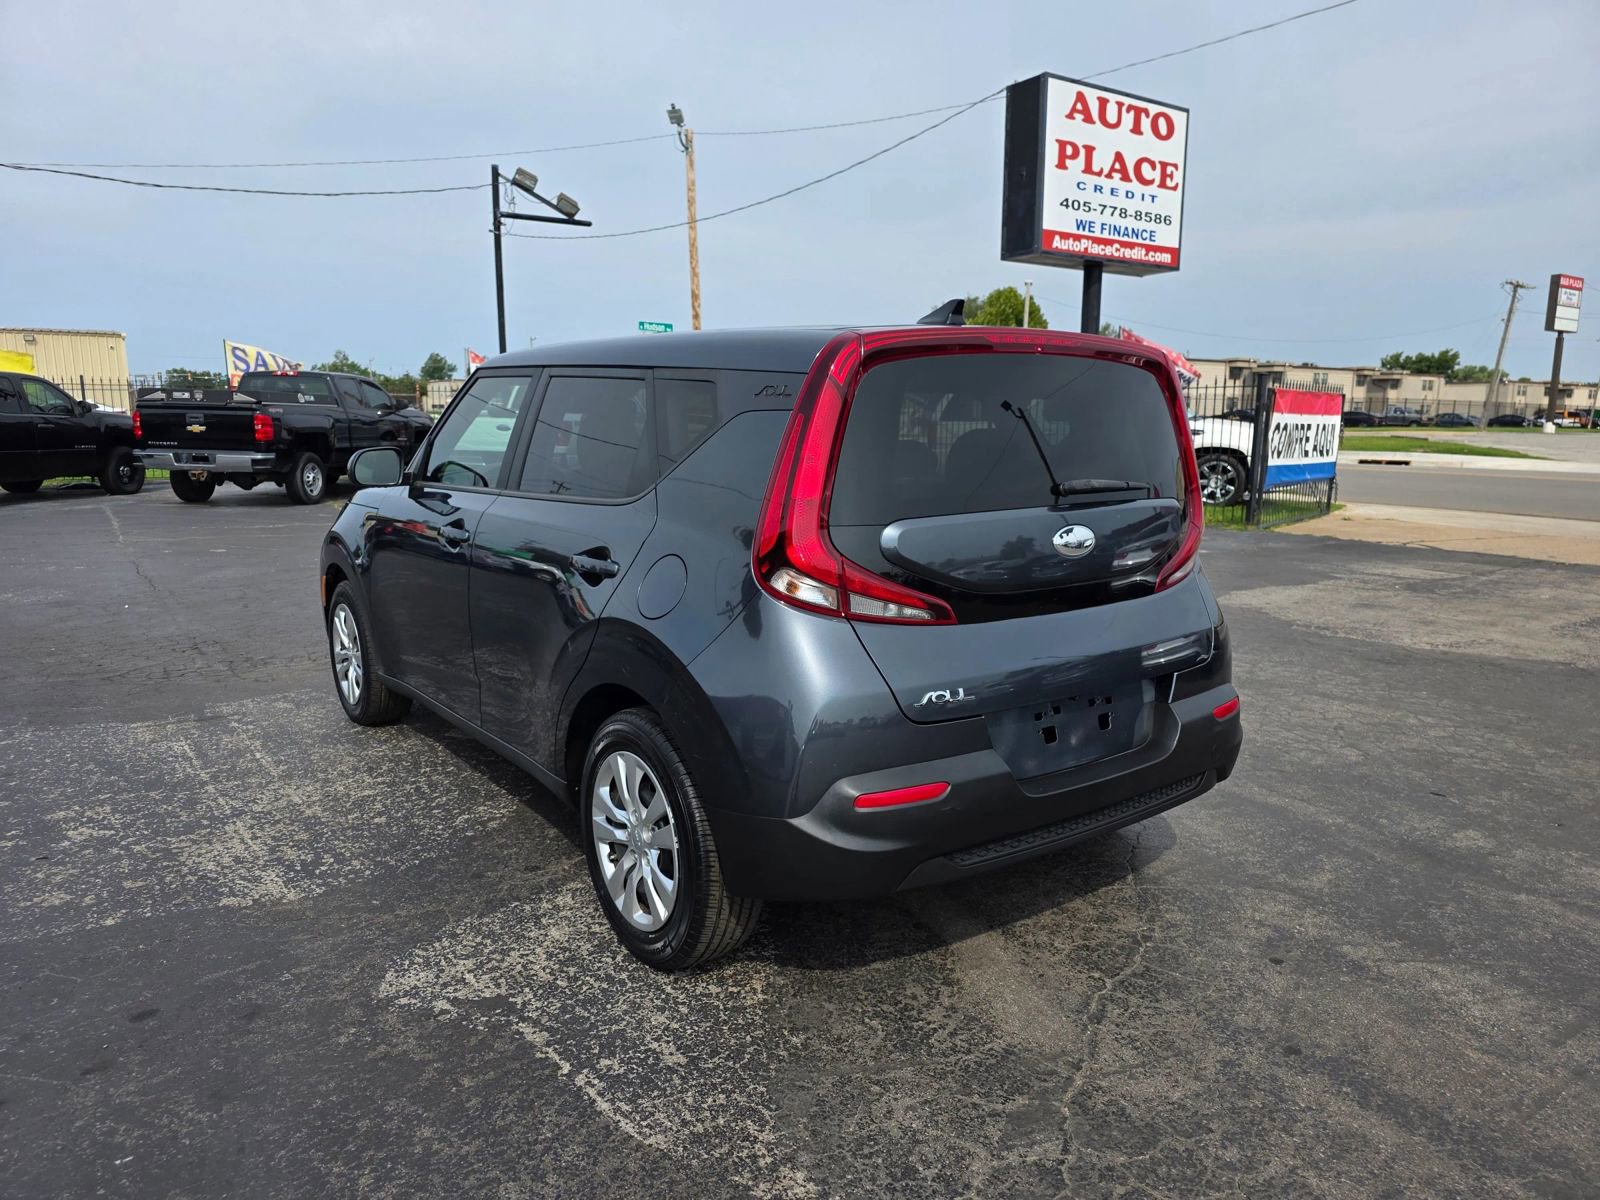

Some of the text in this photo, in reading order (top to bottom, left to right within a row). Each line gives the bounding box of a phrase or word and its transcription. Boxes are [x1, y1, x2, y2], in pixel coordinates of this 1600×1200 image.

[1065, 90, 1175, 141] AUTO
[1055, 138, 1180, 191] PLACE
[1076, 181, 1158, 203] CREDIT
[1059, 197, 1172, 226] 405-778-8586
[1075, 218, 1157, 242] WE FINANCE
[1052, 234, 1171, 263] AutoPlaceCredit.com
[1270, 422, 1336, 459] COMPRE AQUI
